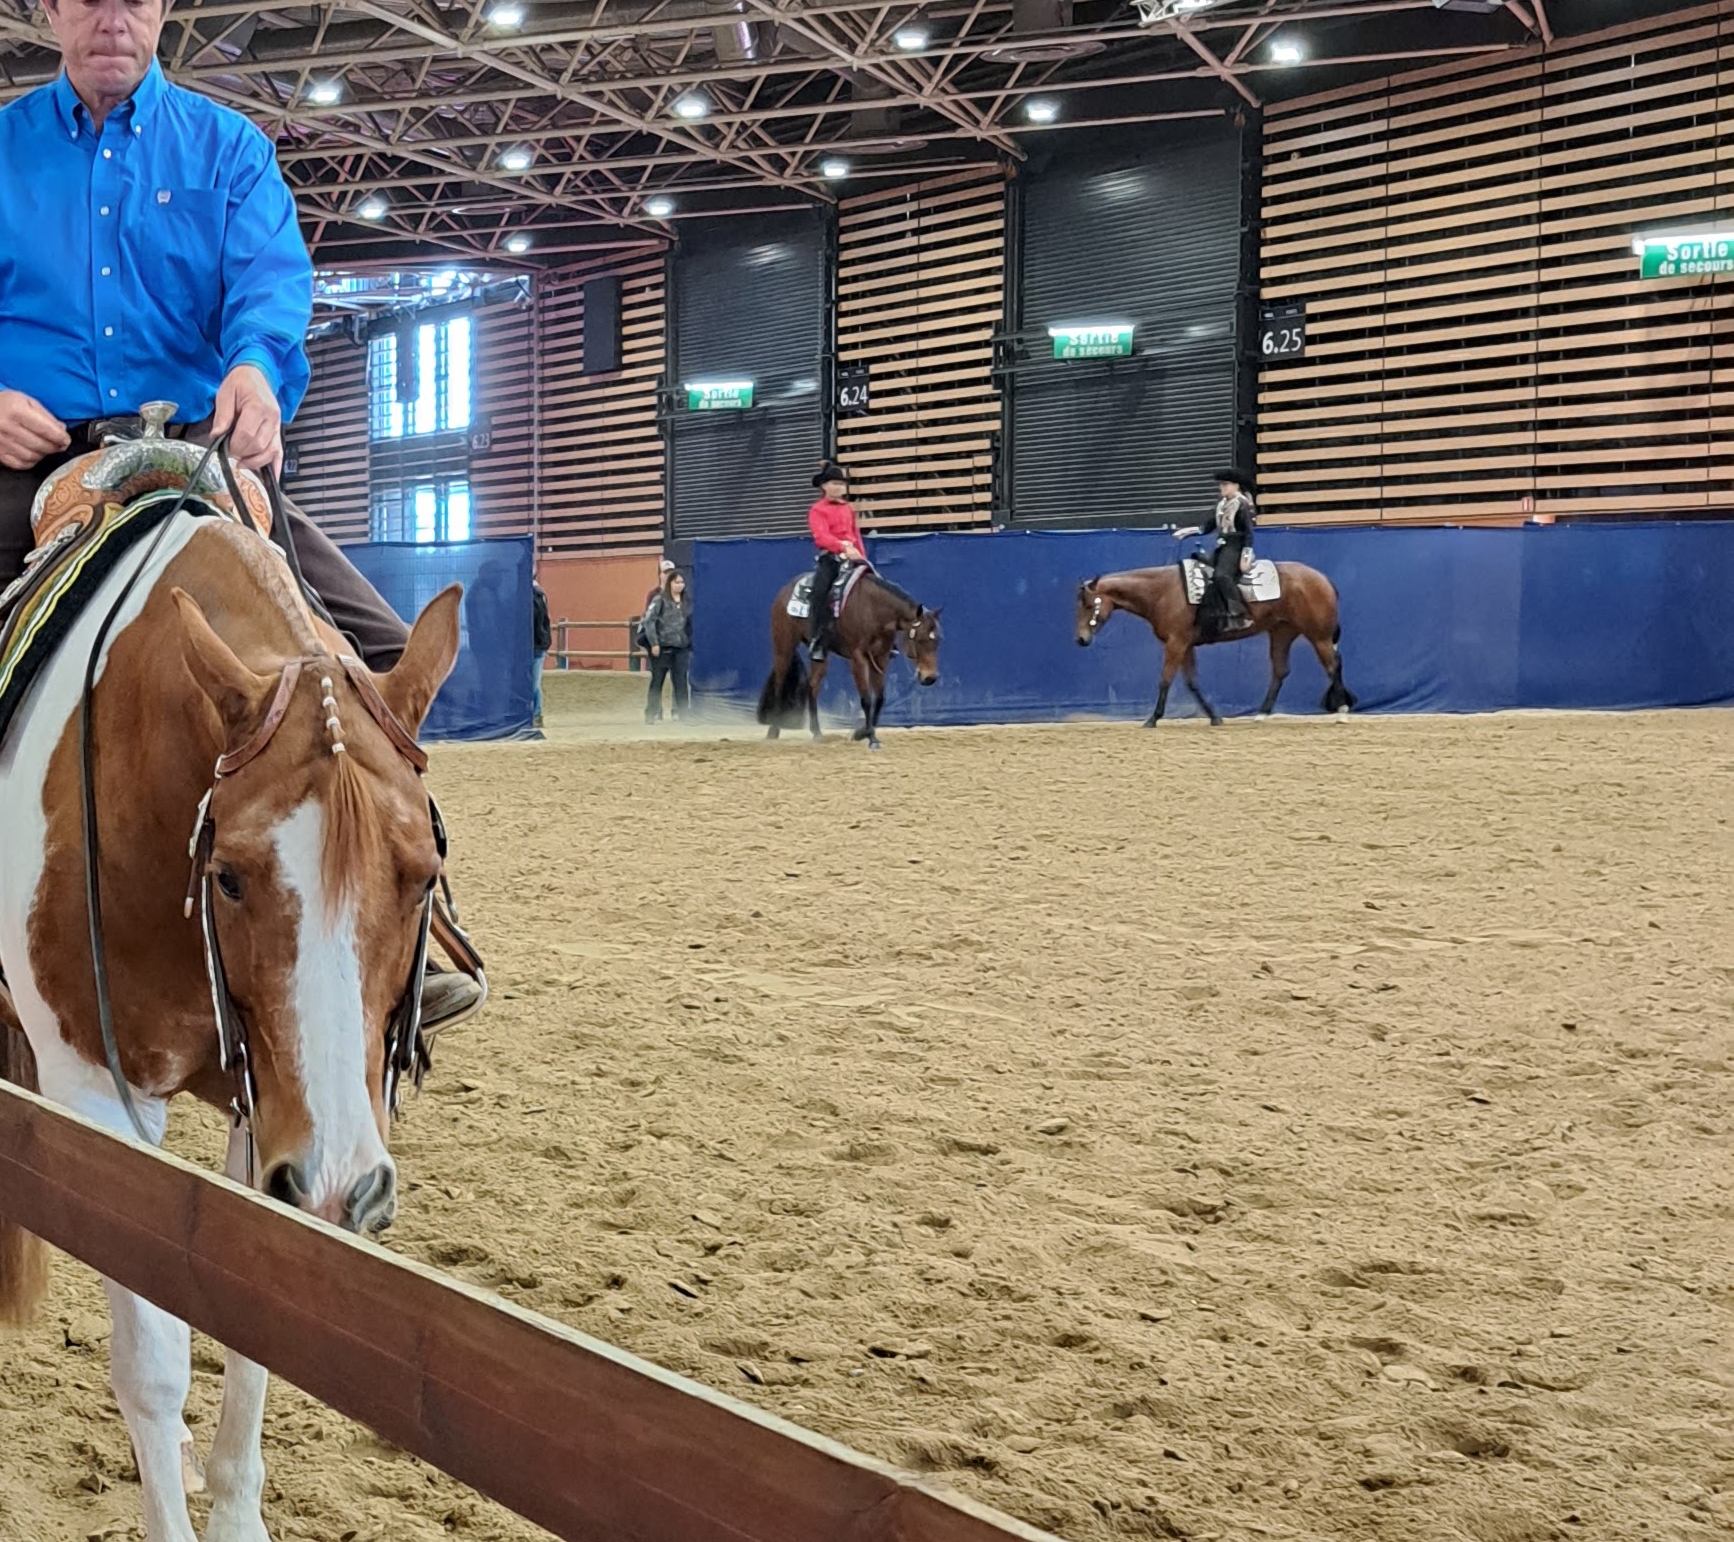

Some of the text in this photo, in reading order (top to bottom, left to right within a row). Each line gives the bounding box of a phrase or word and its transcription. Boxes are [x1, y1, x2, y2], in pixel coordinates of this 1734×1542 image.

[1666, 241, 1729, 261] Sortie
[1658, 258, 1734, 275] de secours
[1262, 327, 1302, 355] 6.25
[840, 384, 869, 406] 6.24
